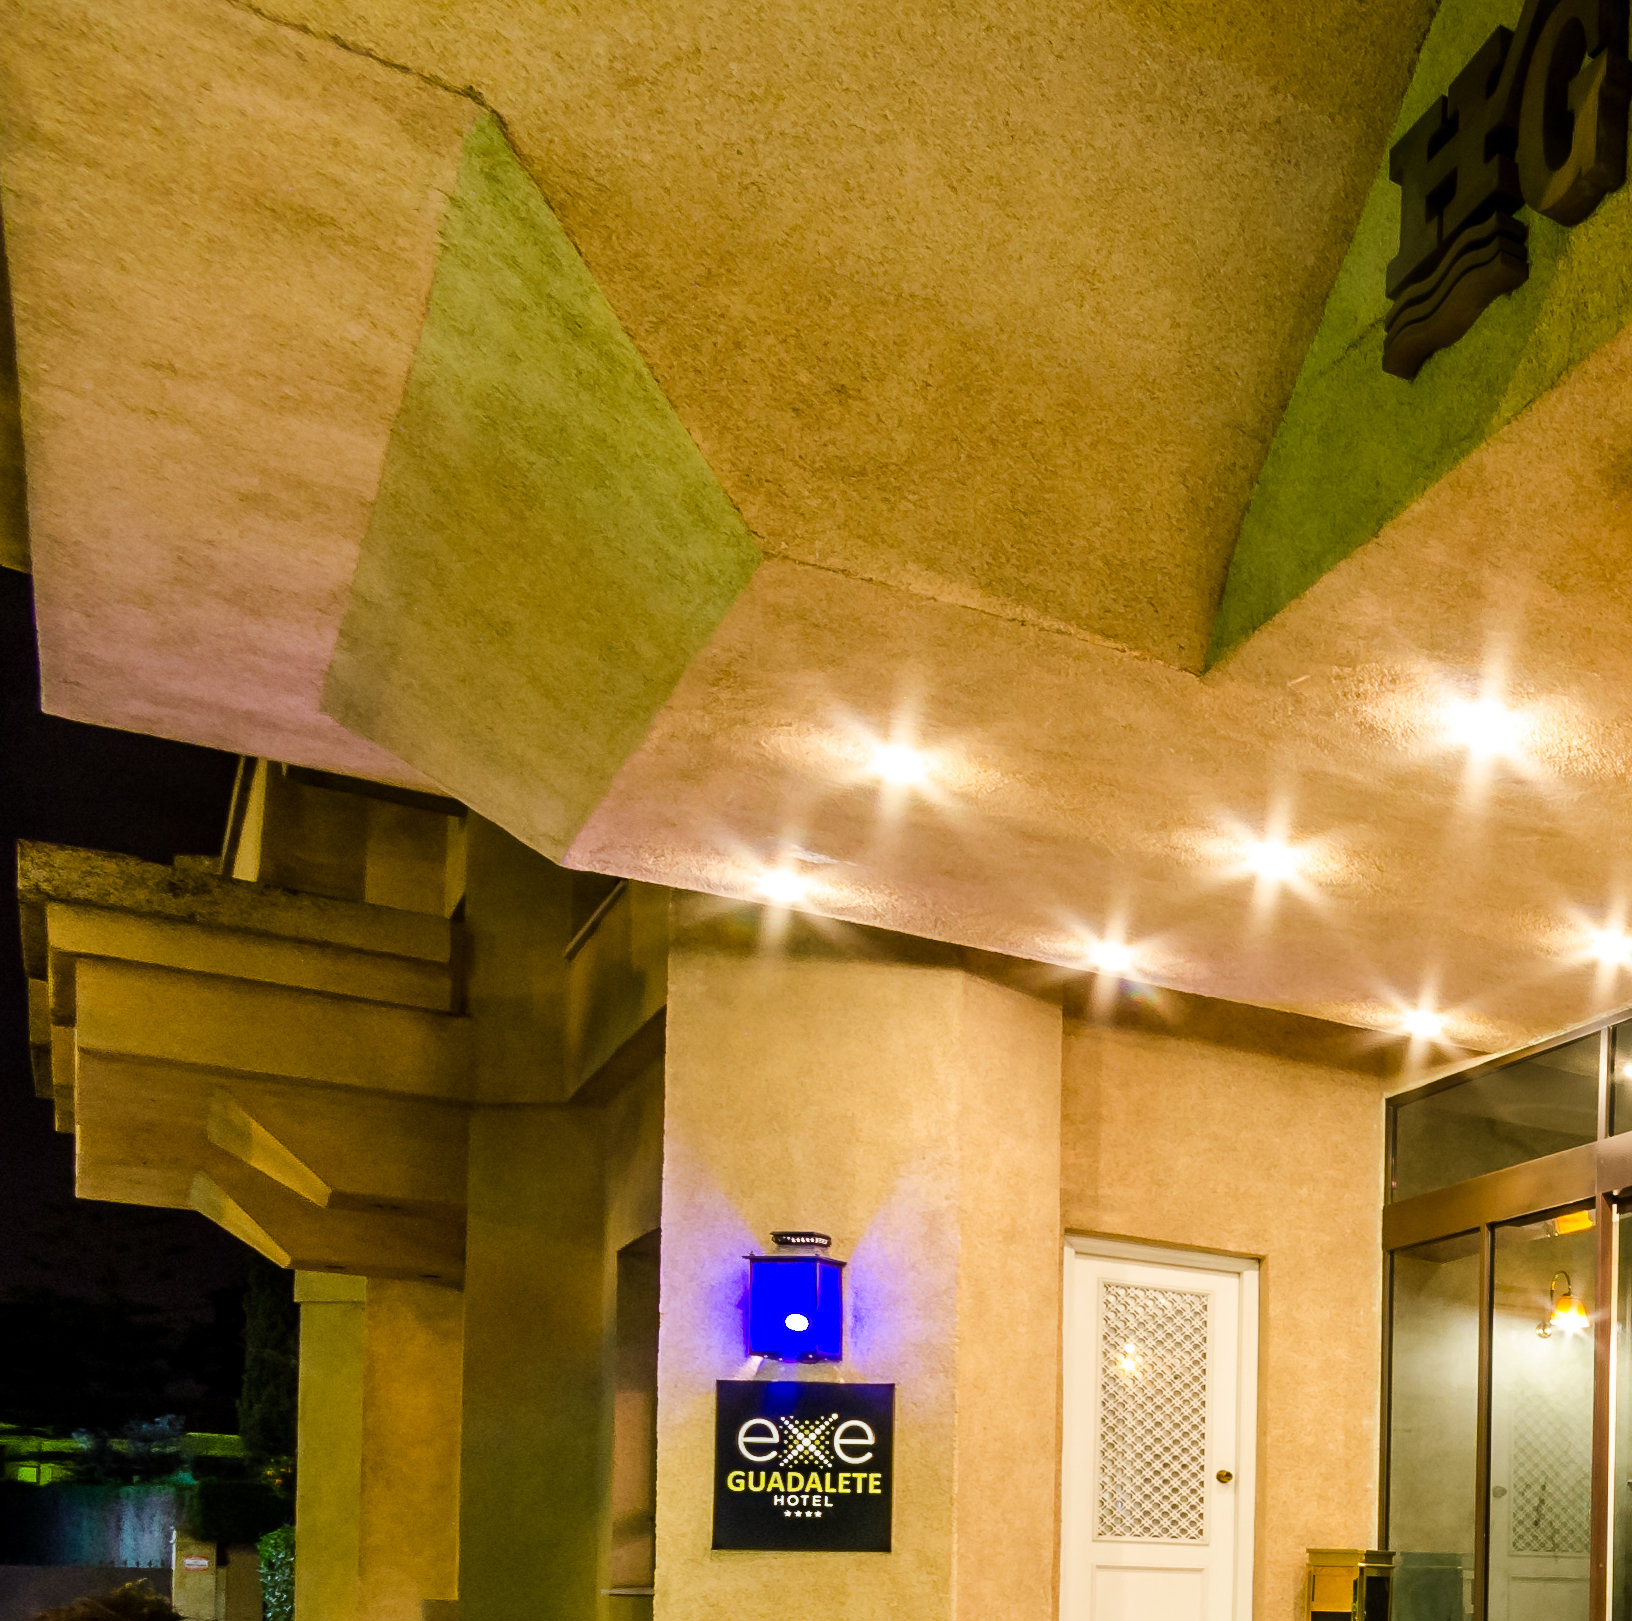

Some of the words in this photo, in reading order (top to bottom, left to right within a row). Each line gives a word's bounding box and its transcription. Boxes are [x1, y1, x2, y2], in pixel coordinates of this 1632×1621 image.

[737, 1413, 876, 1468] exe
[726, 1470, 882, 1495] GUADALETE
[773, 1494, 834, 1507] HOTEL
